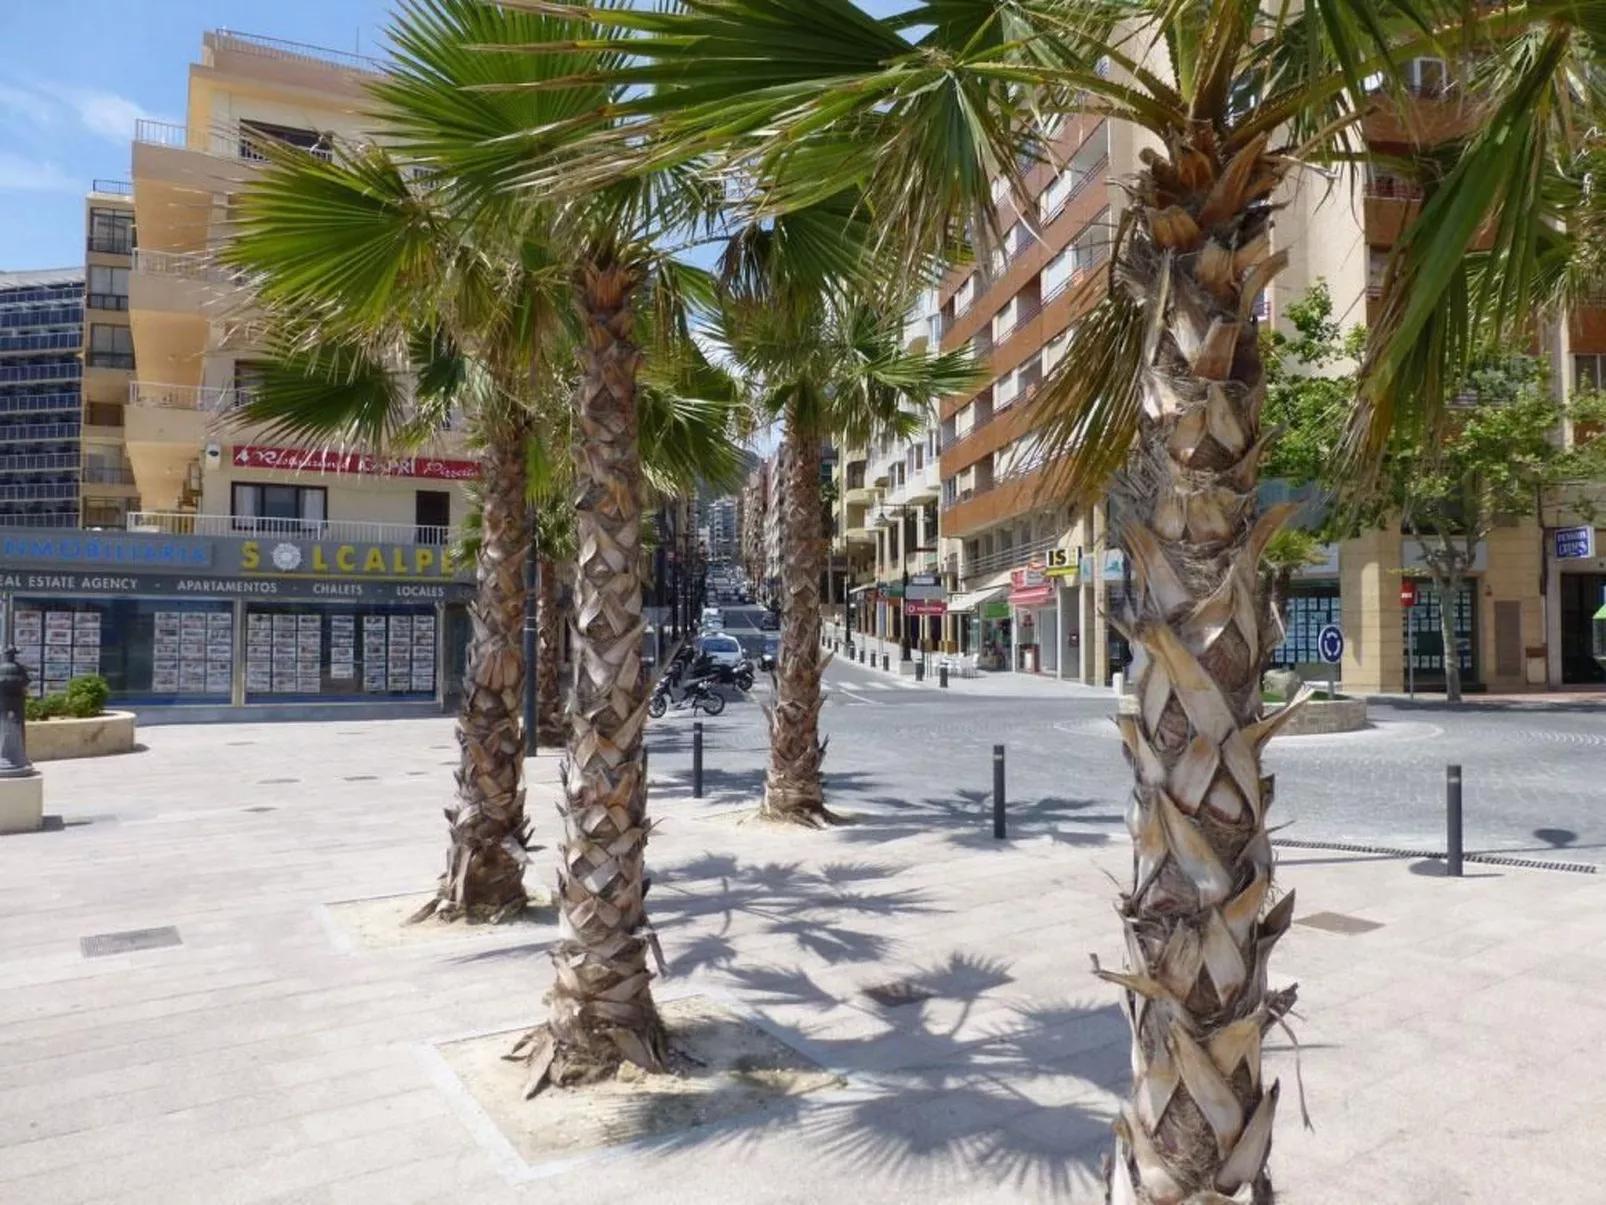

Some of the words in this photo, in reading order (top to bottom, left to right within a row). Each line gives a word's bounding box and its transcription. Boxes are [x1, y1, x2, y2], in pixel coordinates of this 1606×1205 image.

[28, 576, 76, 589] ESTATE
[82, 577, 139, 590] AGENCY
[177, 579, 278, 594] APARTAMENTOS
[313, 582, 363, 596] CHALETS
[396, 585, 445, 598] LOCALES
